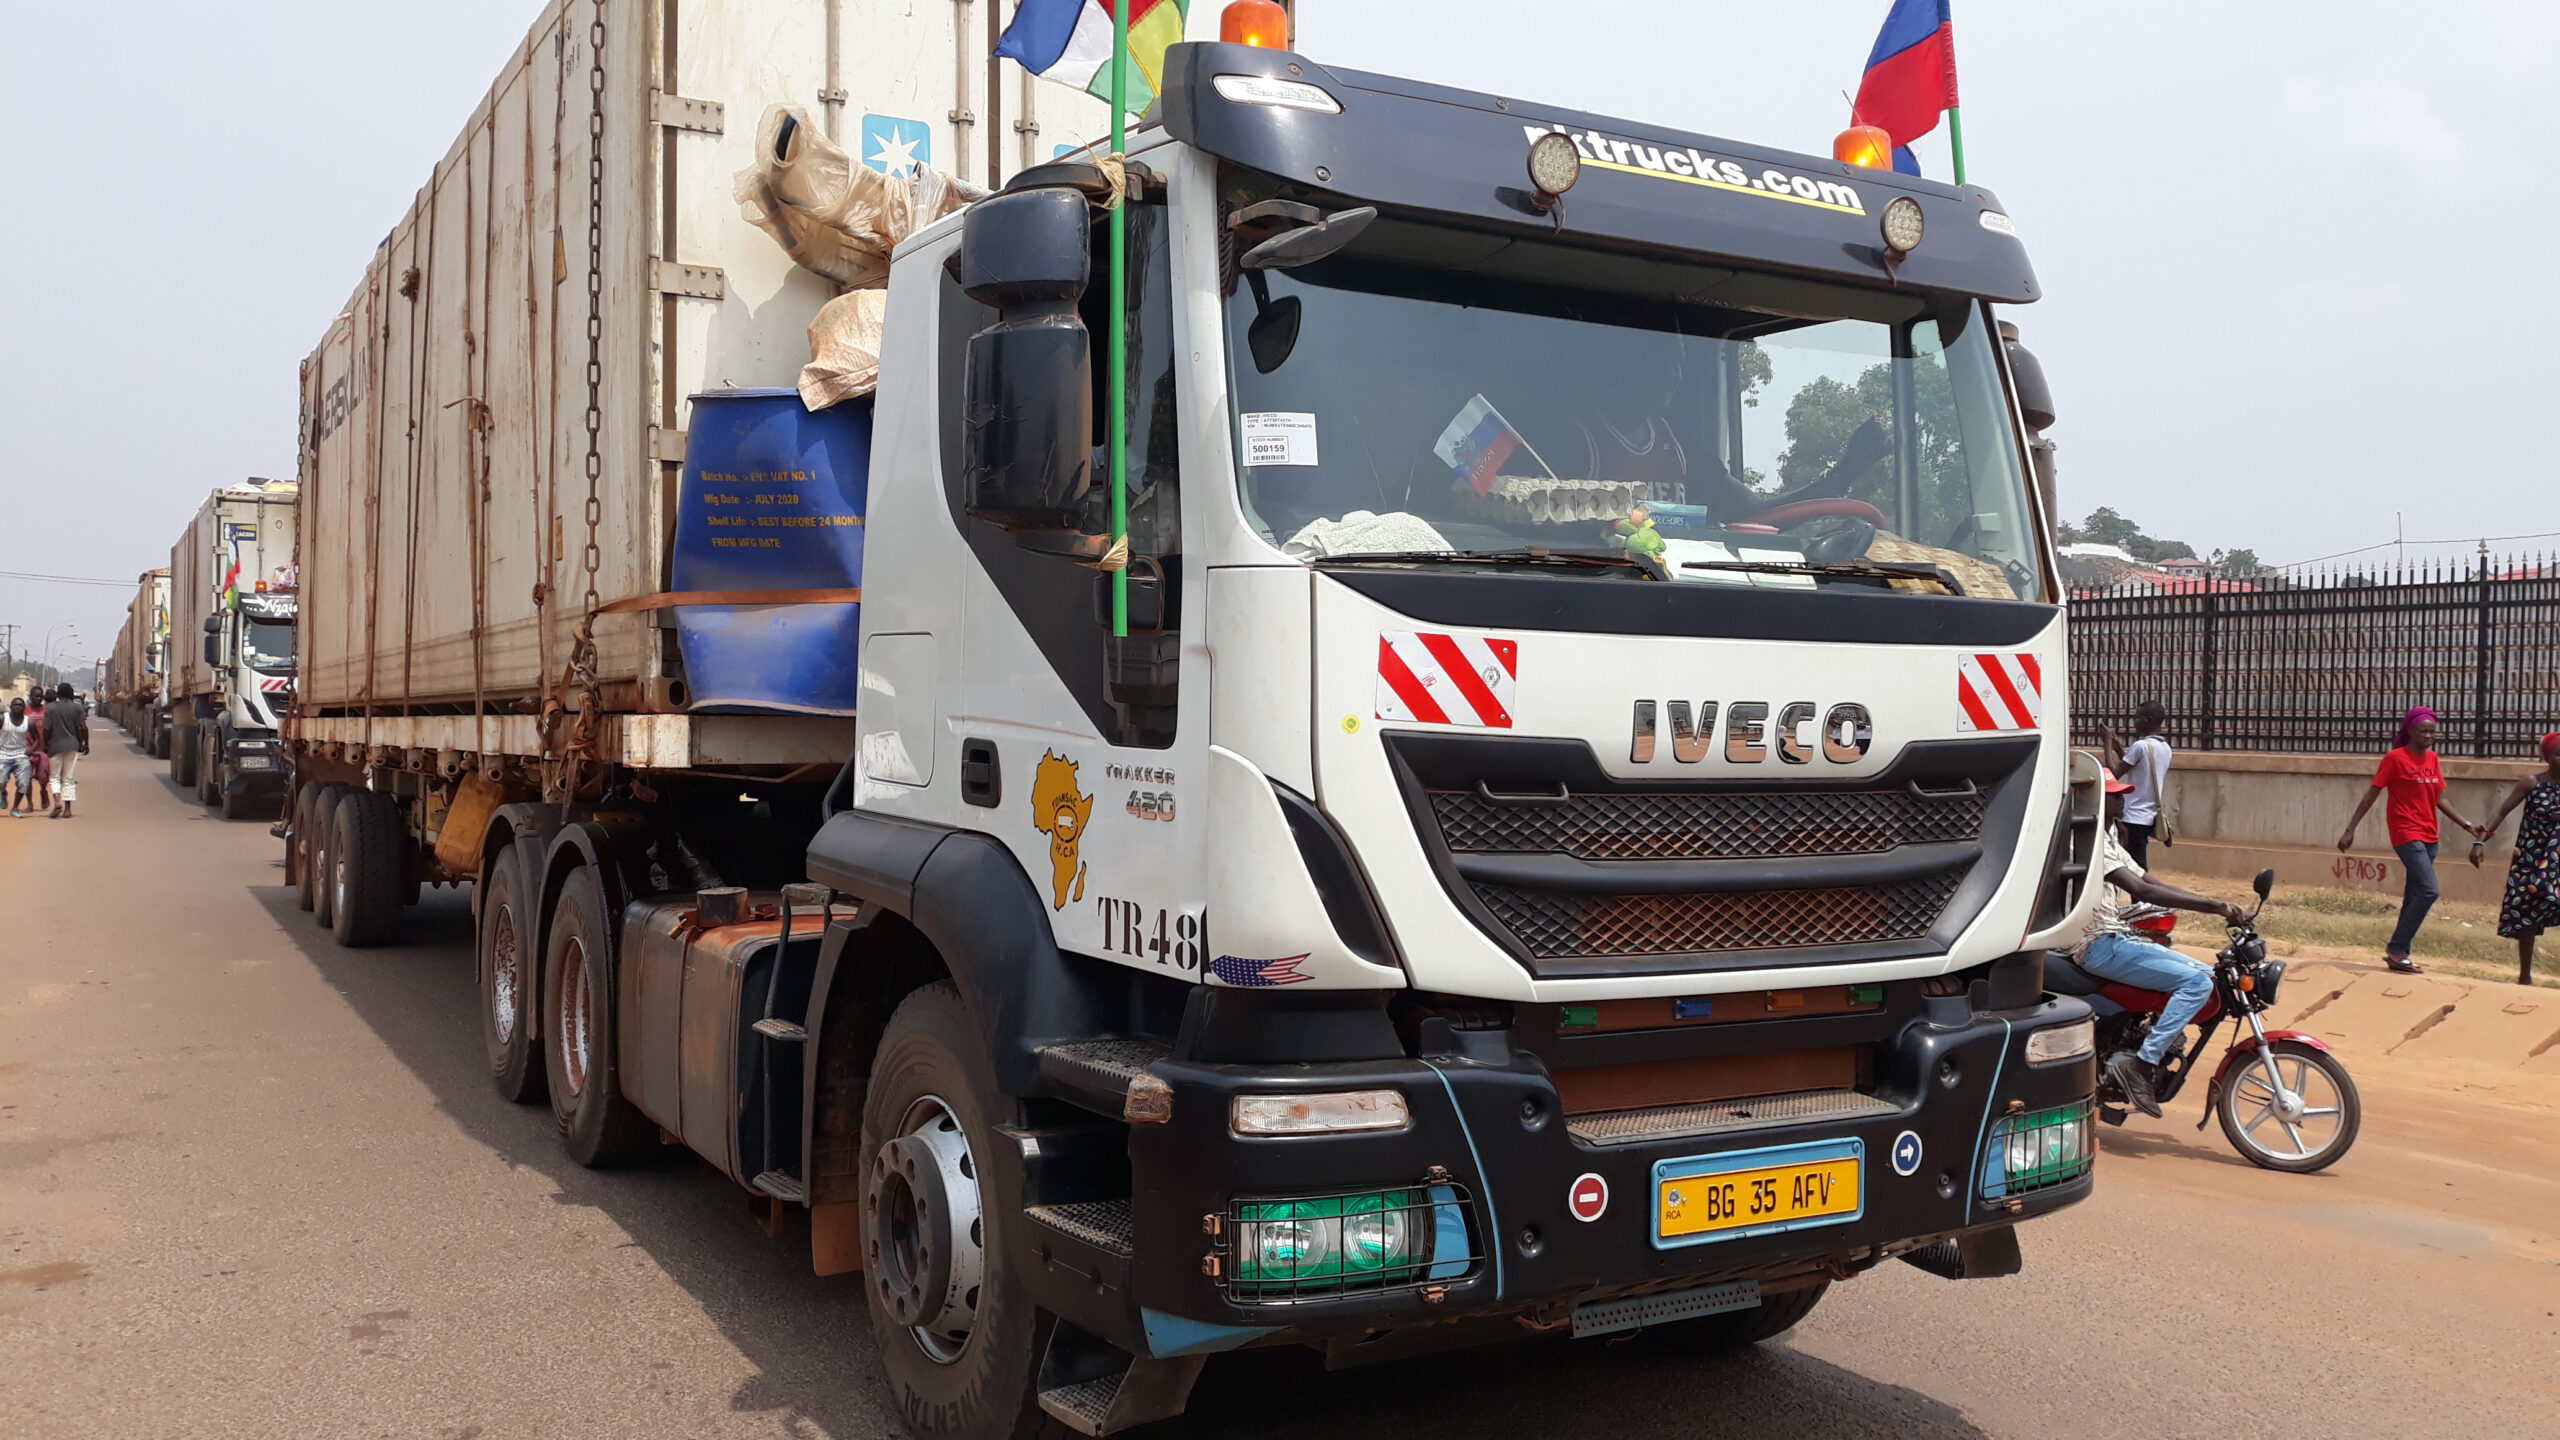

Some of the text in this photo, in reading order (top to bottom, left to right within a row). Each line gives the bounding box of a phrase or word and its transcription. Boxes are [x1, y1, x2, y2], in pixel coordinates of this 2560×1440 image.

[1252, 444, 1285, 453] 500159
[791, 471, 808, 481] NO.
[811, 471, 816, 481] 1
[720, 494, 740, 504] Date
[754, 494, 775, 504] JULY
[777, 494, 799, 504] 2020
[707, 516, 728, 526] Shelf
[731, 516, 746, 526] Life
[757, 516, 779, 527] BEST
[782, 516, 816, 527] BEFORE
[819, 516, 831, 526] 24
[712, 538, 781, 548] FROM MFG DATE
[1630, 699, 1873, 764] IVECO
[1105, 762, 1175, 785] TRAKKER
[1126, 790, 1176, 822] 420
[1098, 897, 1198, 971] TR48
[1708, 1171, 1831, 1221] BG 35 AFV
[1666, 1211, 1682, 1221] RCA
